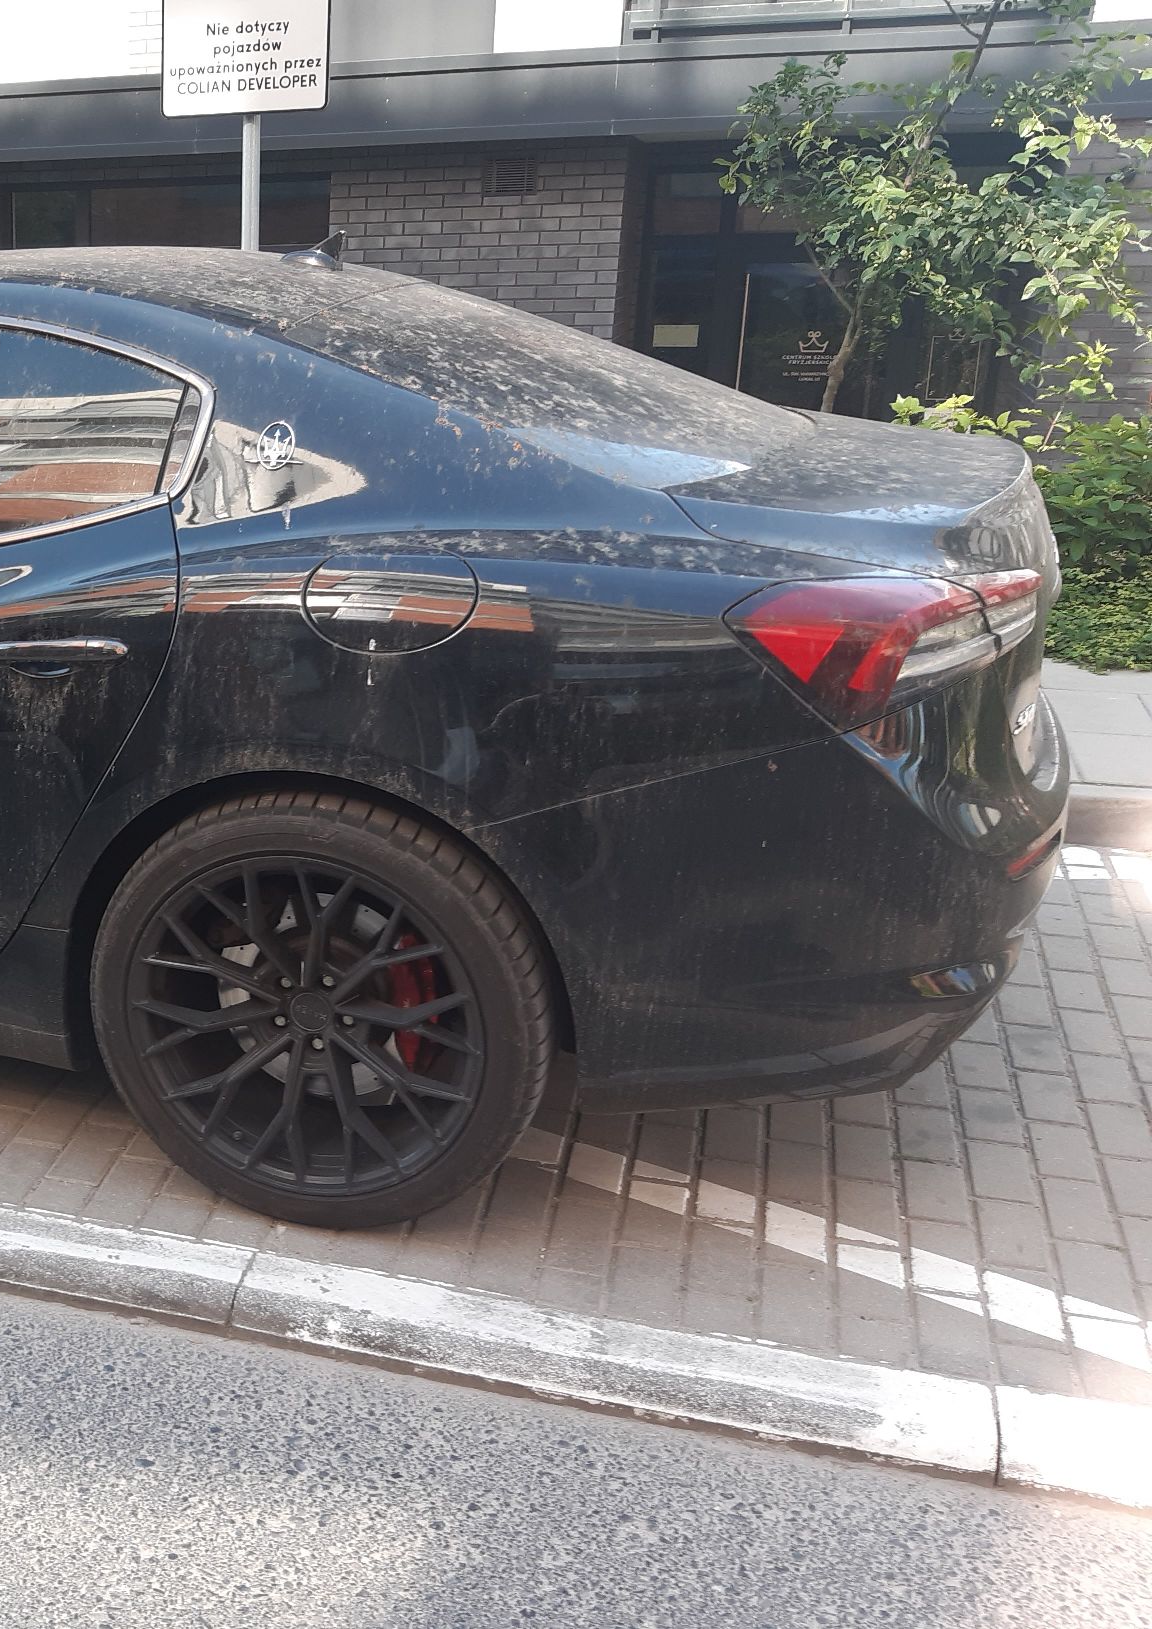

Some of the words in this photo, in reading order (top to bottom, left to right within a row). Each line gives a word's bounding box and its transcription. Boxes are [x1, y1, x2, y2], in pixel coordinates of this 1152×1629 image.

[206, 23, 229, 36] Nie
[235, 20, 289, 36] dotyczy
[213, 38, 282, 58] pojazdów
[169, 57, 277, 80] upoważnionych
[284, 57, 322, 72] przez
[177, 79, 231, 95] COLIAN
[237, 73, 318, 92] DEVELOPER
